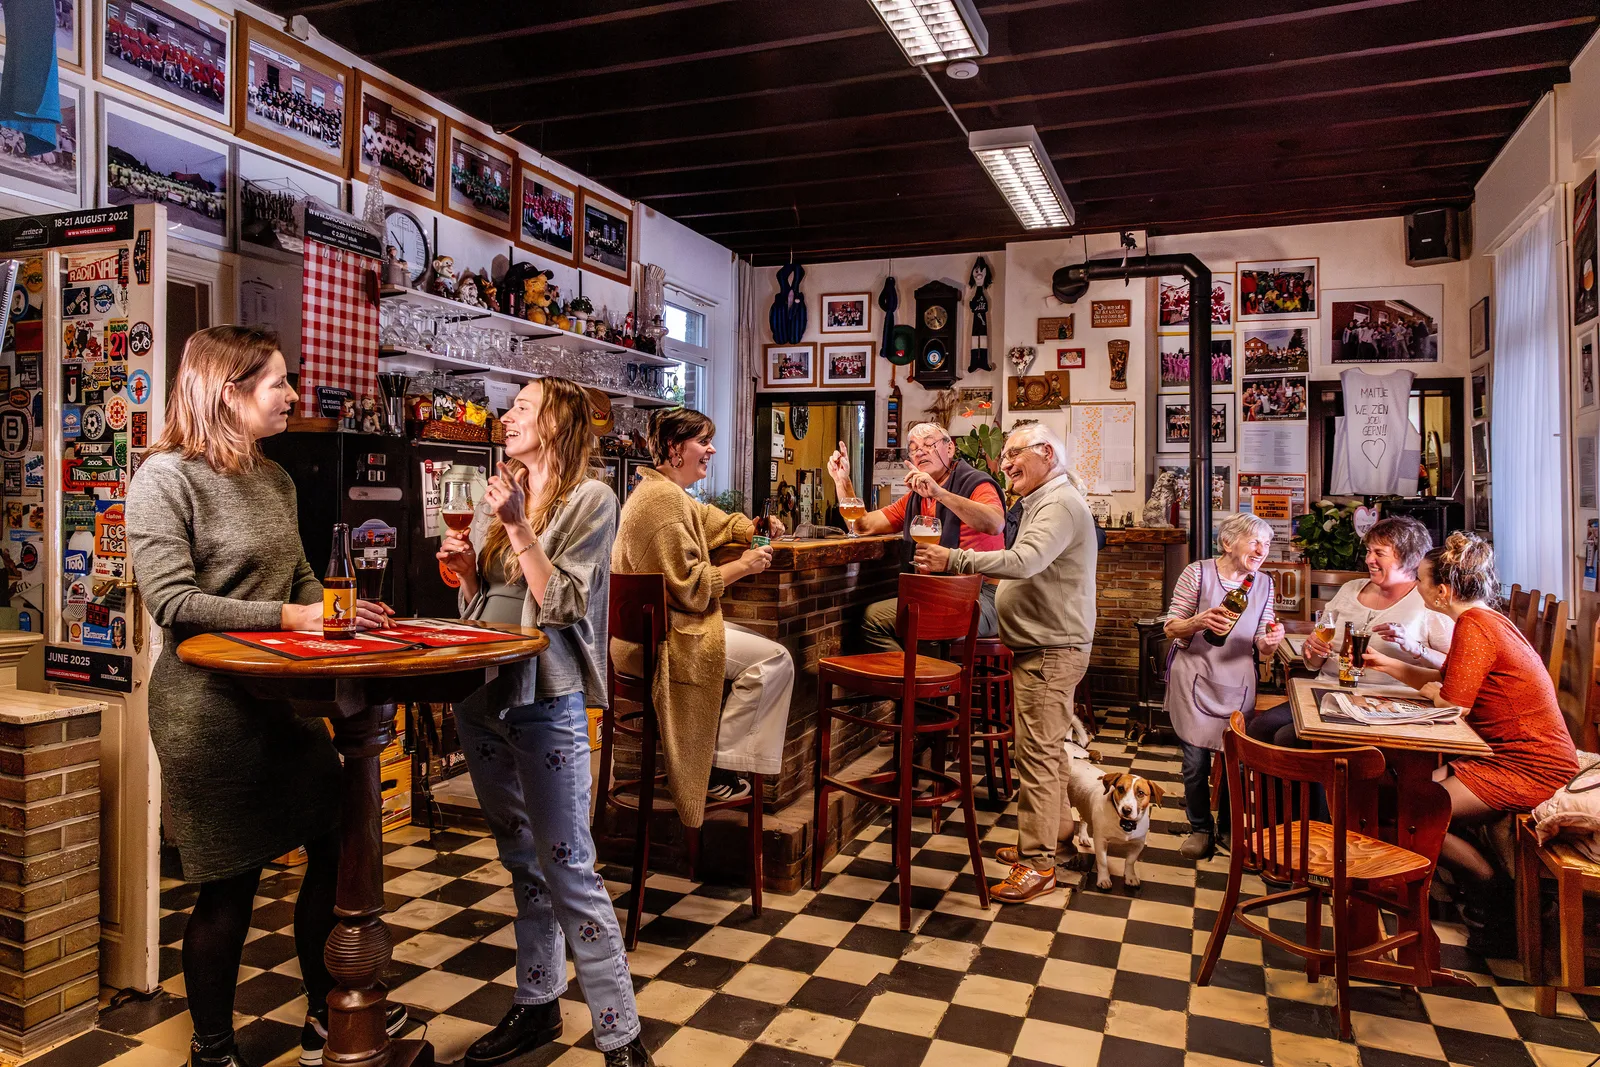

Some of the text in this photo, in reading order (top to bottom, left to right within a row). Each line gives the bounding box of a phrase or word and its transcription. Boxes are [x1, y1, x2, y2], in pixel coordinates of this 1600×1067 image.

[54, 211, 129, 228] 18-21 AUGUST 2022
[21, 228, 43, 236] ardeca
[69, 264, 96, 281] RADIO
[109, 332, 127, 358] 21
[322, 388, 348, 396] ATTENTION
[1355, 405, 1368, 415] WE
[72, 467, 92, 480] YPRES
[102, 524, 126, 540] Ice
[101, 537, 126, 553] Tea
[1224, 610, 1239, 618] CON
[47, 652, 91, 667] JUNE 2025
